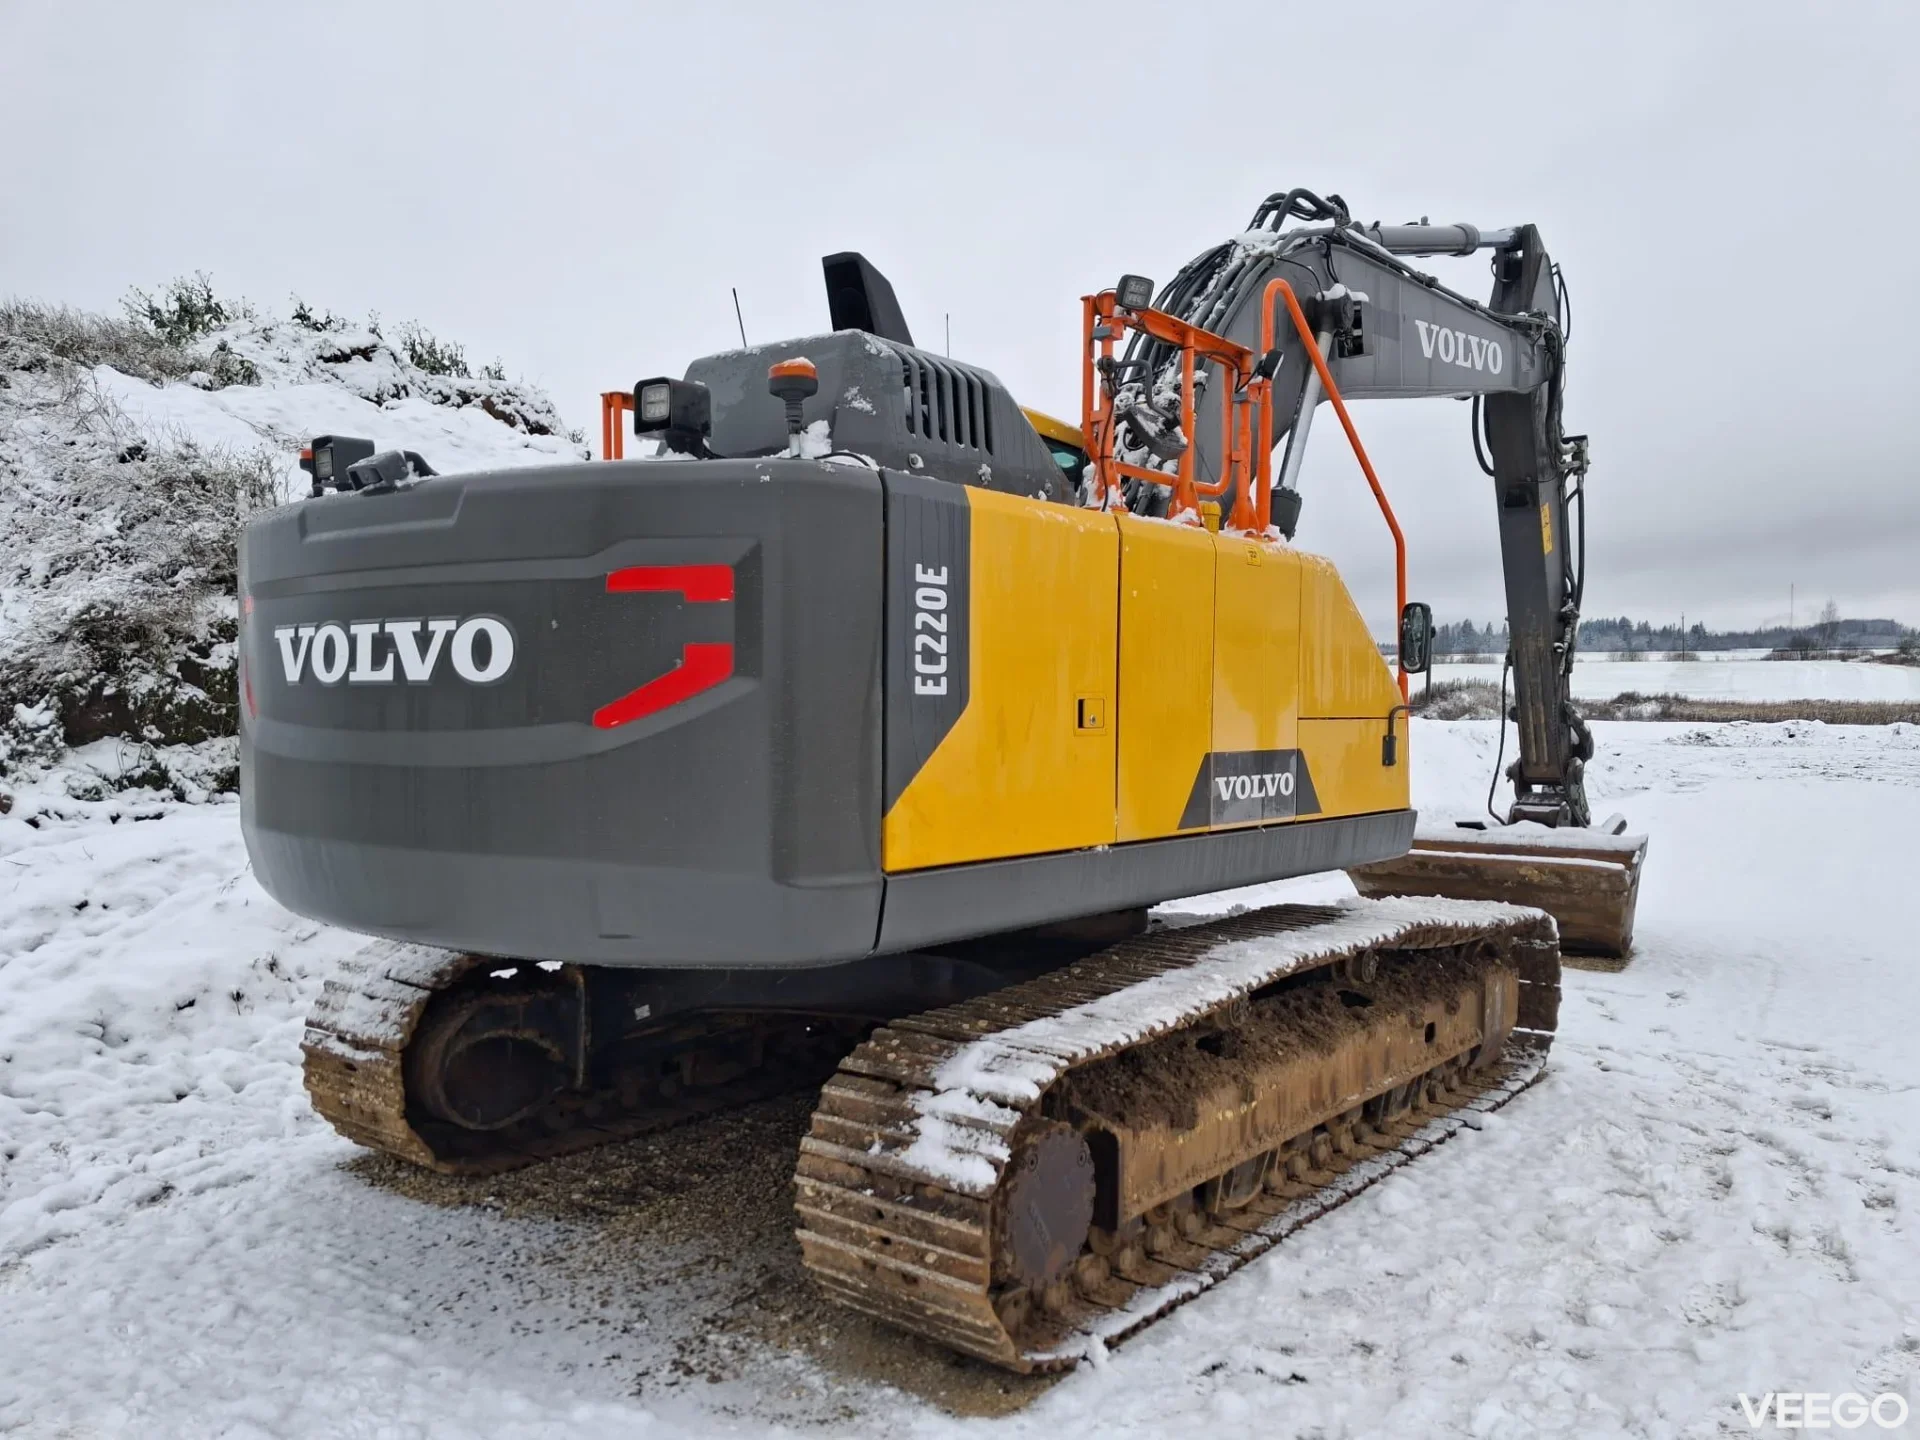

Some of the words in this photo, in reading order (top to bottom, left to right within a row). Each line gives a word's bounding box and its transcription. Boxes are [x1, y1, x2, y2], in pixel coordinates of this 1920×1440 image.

[1415, 319, 1503, 374] VOLVO
[274, 616, 515, 684] VOLVO
[914, 564, 948, 696] EC220E
[1214, 772, 1295, 801] VOLVO
